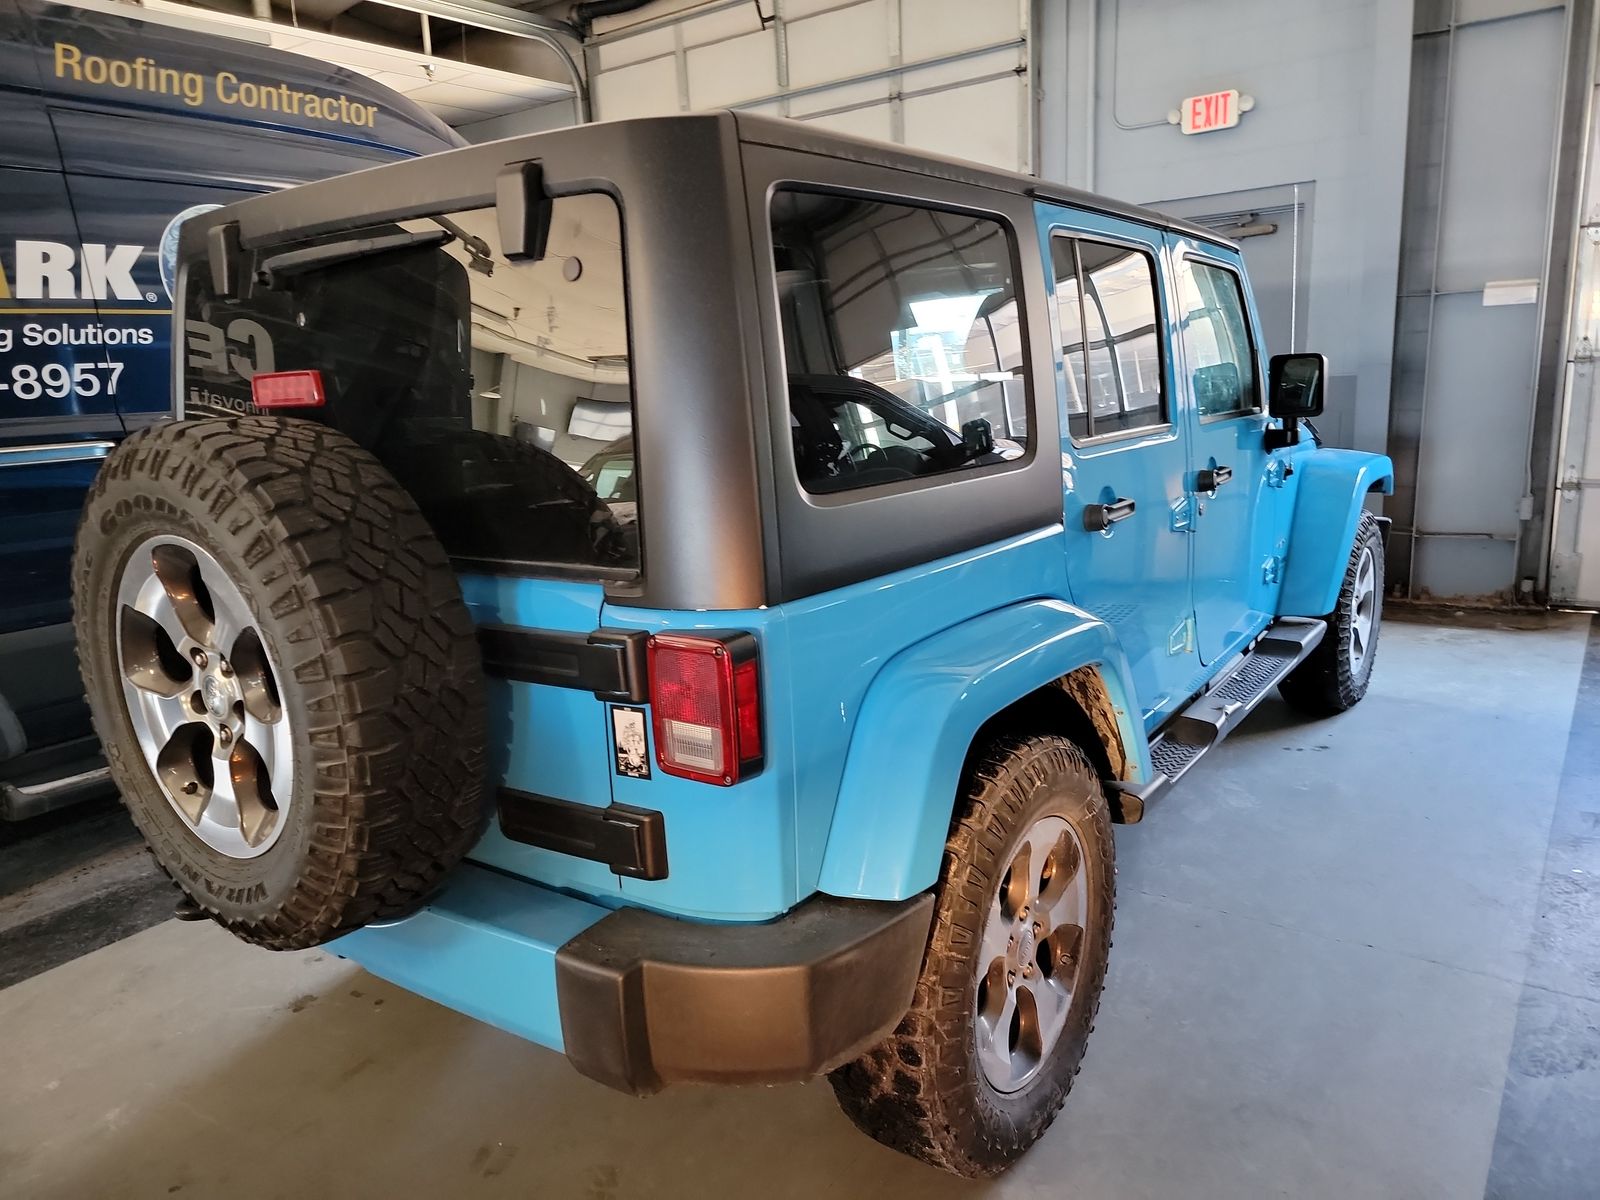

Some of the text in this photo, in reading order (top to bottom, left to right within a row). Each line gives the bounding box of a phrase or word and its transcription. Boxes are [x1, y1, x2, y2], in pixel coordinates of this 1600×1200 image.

[53, 42, 378, 128] Roofing Contractor
[1191, 93, 1231, 130] EXIT
[22, 323, 154, 346] Solutions
